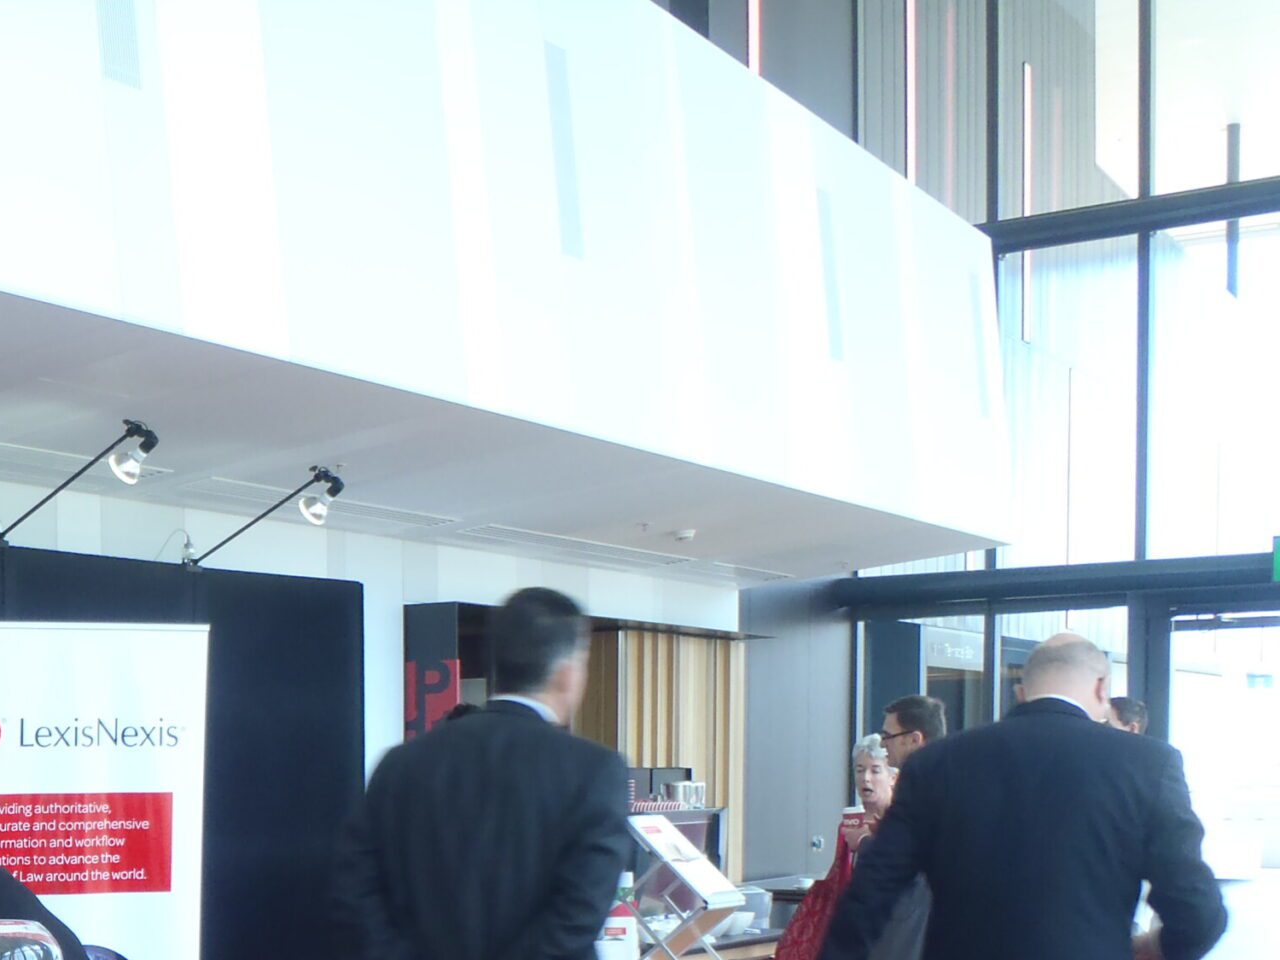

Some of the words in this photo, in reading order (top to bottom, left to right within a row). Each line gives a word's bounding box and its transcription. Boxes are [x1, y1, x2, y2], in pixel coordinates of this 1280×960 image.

[19, 717, 180, 748] LexisNexis
[34, 801, 112, 814] authoritative,
[32, 819, 56, 831] and
[58, 818, 150, 833] comprehensive
[49, 836, 73, 848] and
[75, 834, 126, 847] workflow
[33, 855, 47, 865] to
[49, 853, 99, 865] advance
[101, 852, 121, 863] the
[19, 871, 44, 882] Law
[45, 870, 89, 882] around
[91, 869, 111, 880] the
[112, 868, 147, 880] world.
